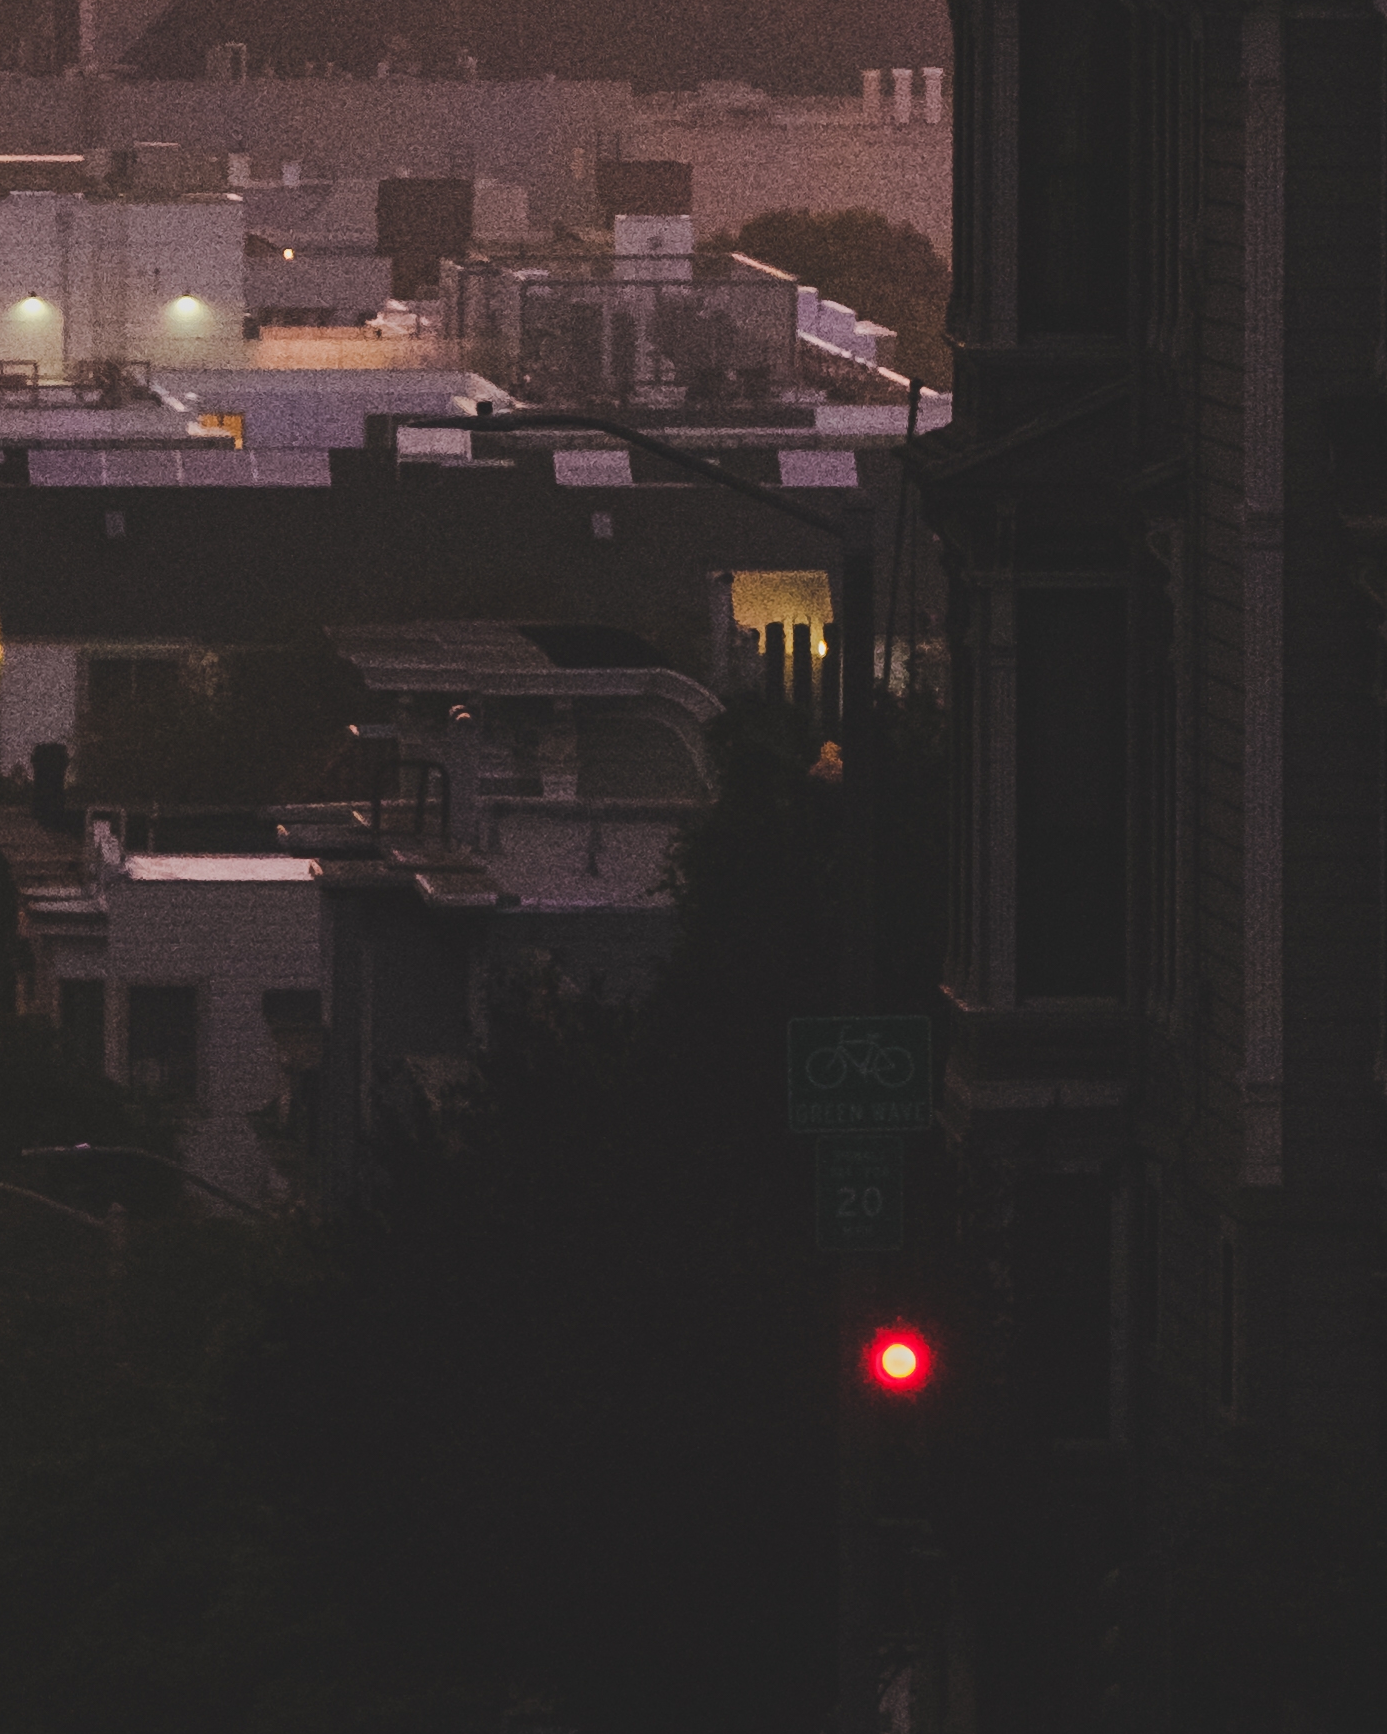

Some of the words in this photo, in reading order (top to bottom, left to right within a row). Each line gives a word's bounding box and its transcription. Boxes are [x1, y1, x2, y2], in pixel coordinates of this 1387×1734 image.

[795, 1102, 863, 1124] GREEN
[870, 1100, 926, 1123] WAVE
[835, 1185, 884, 1218] 20
